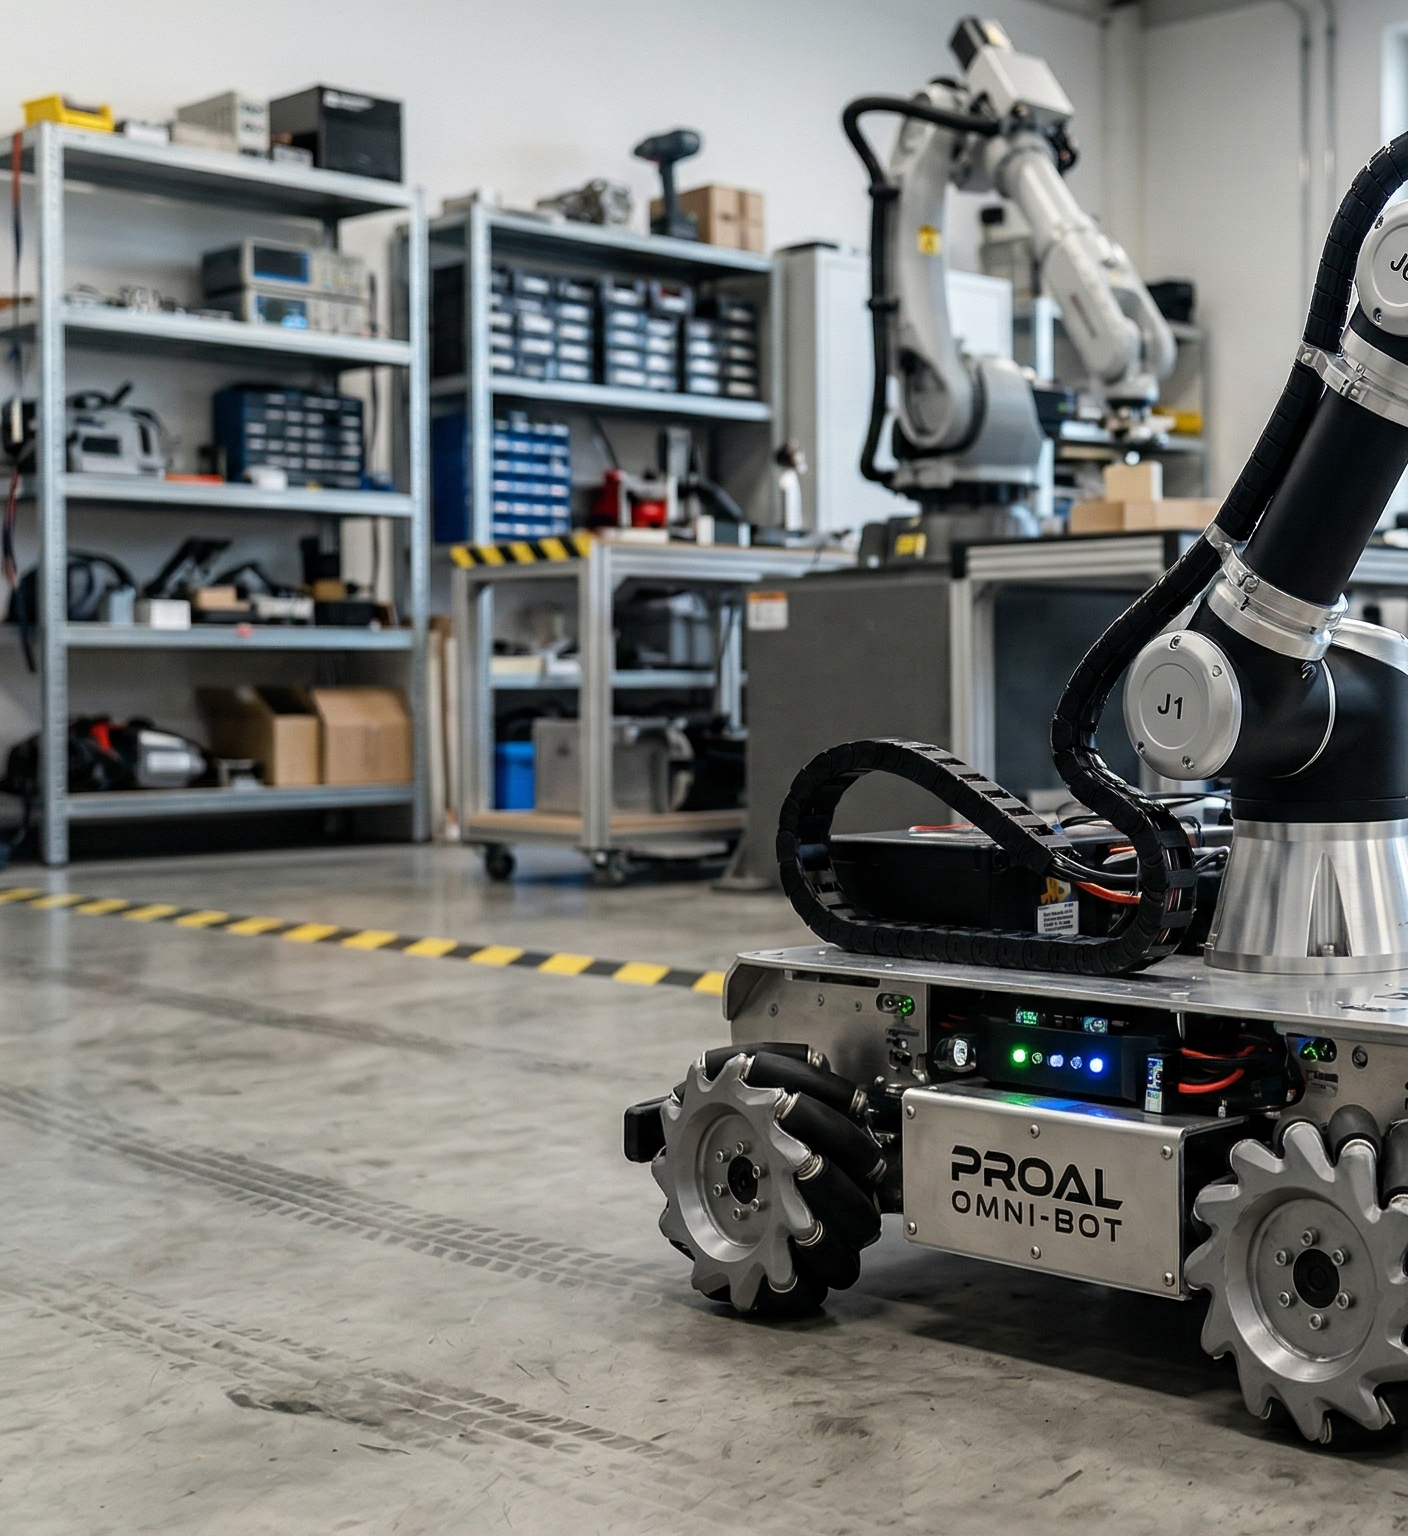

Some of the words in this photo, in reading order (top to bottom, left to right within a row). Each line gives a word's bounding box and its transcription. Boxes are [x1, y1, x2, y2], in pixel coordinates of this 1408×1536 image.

[1157, 693, 1183, 720] J1
[951, 1145, 1124, 1210] PROAL
[951, 1190, 1122, 1242] OMNI-BOT
